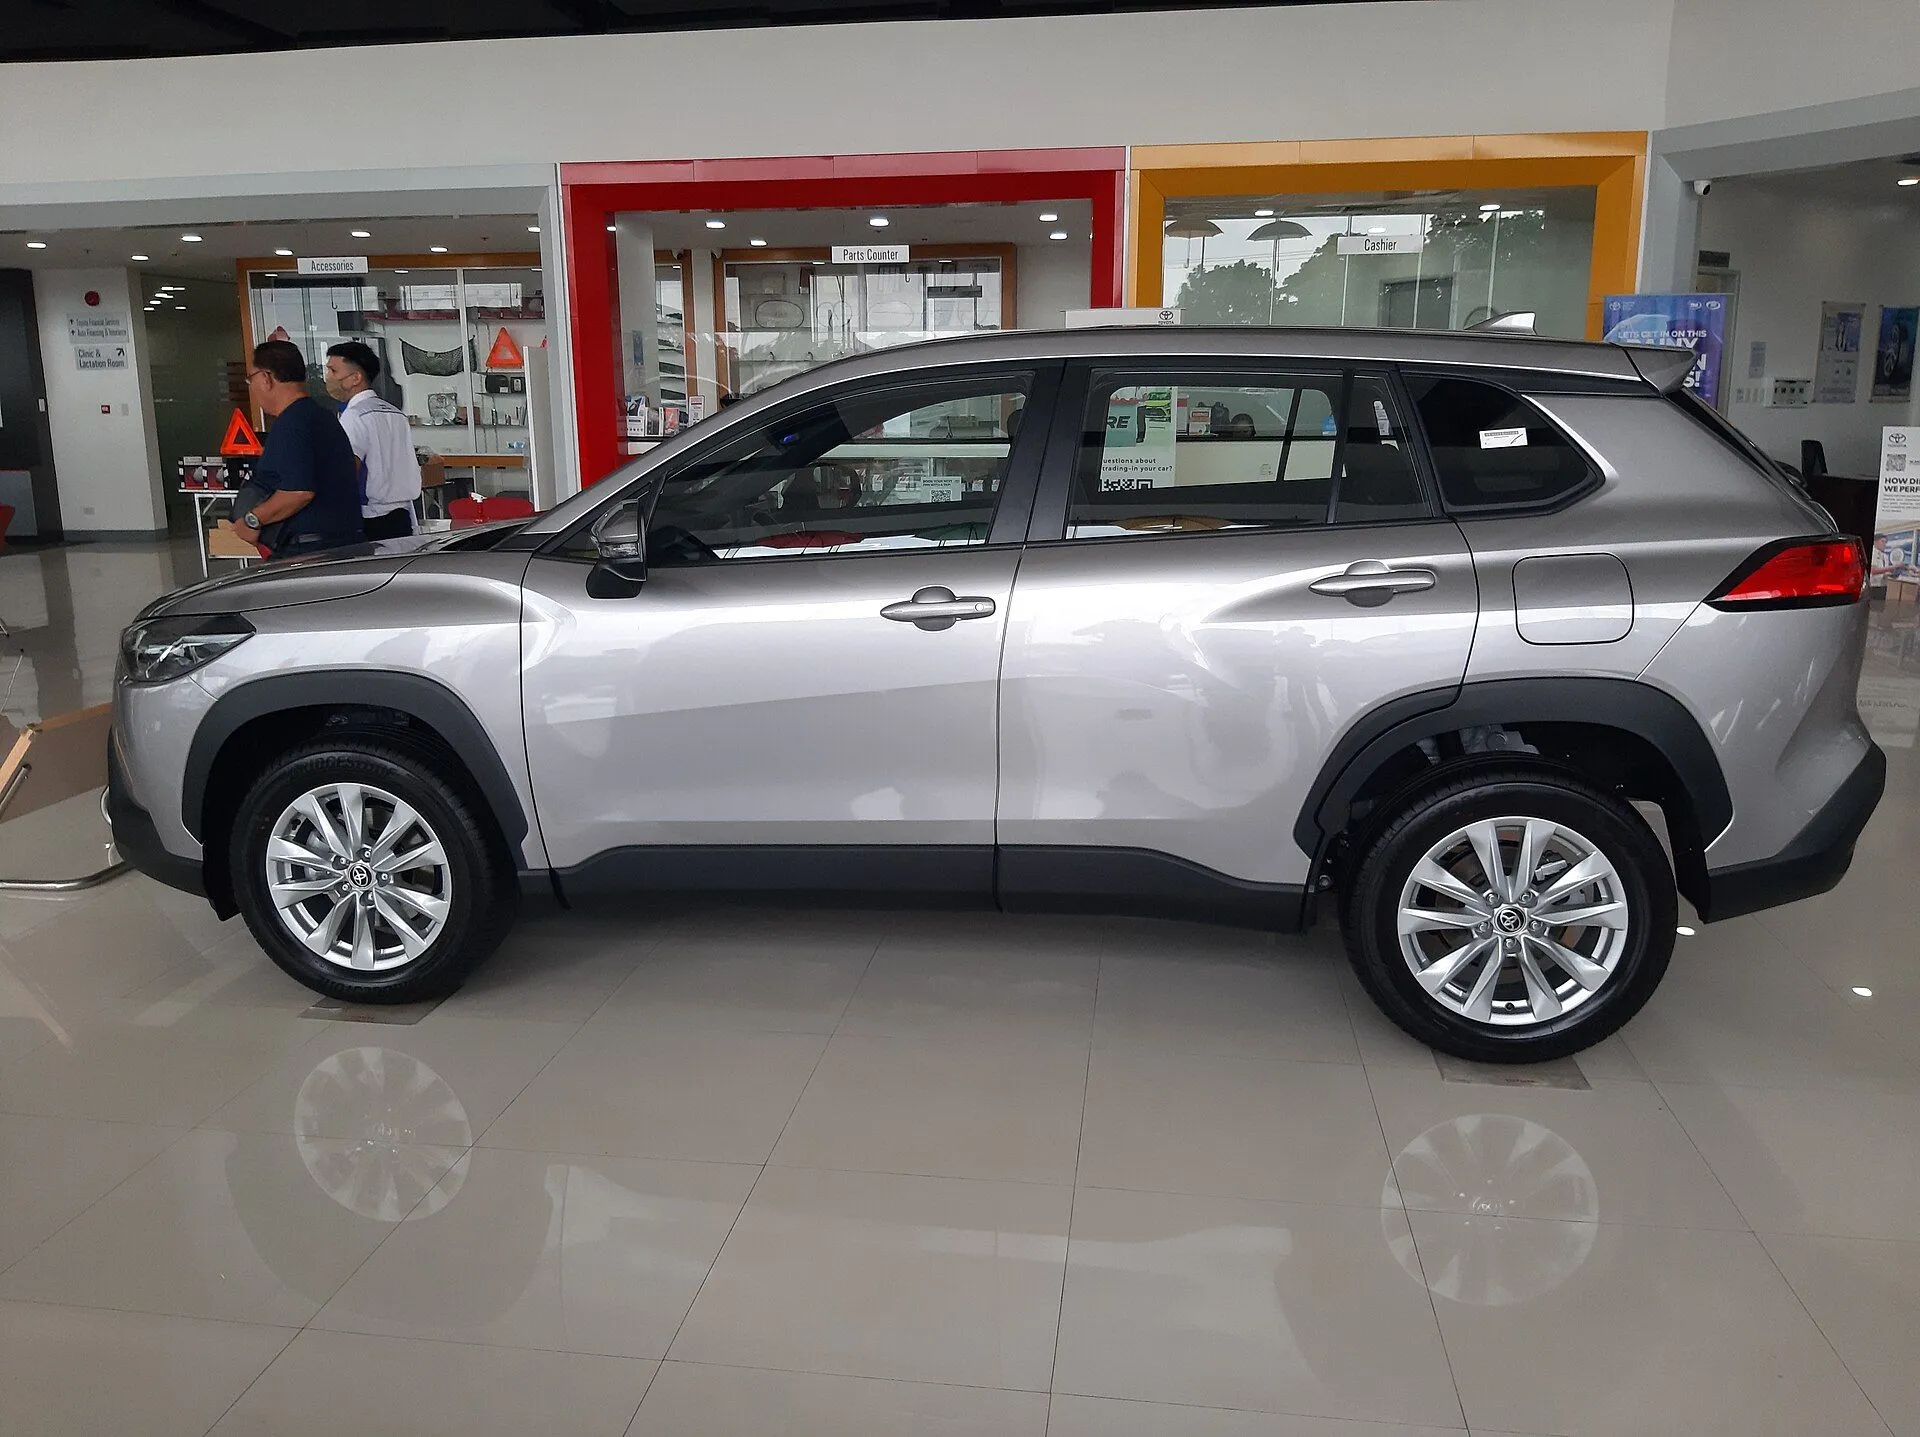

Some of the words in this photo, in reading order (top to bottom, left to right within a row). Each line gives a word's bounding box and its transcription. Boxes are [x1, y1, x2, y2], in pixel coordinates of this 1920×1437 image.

[1364, 238, 1397, 251] Cashier
[843, 249, 865, 261] Parts
[867, 248, 899, 261] Counter
[311, 260, 354, 271] Accessories
[1660, 330, 1670, 338] IN
[1671, 330, 1685, 338] ON
[1687, 330, 1707, 338] THIS
[78, 349, 94, 358] Clinic
[95, 349, 101, 358] &
[79, 360, 106, 369] Lactation
[107, 359, 125, 368] Room
[1884, 477, 1908, 485] HOW
